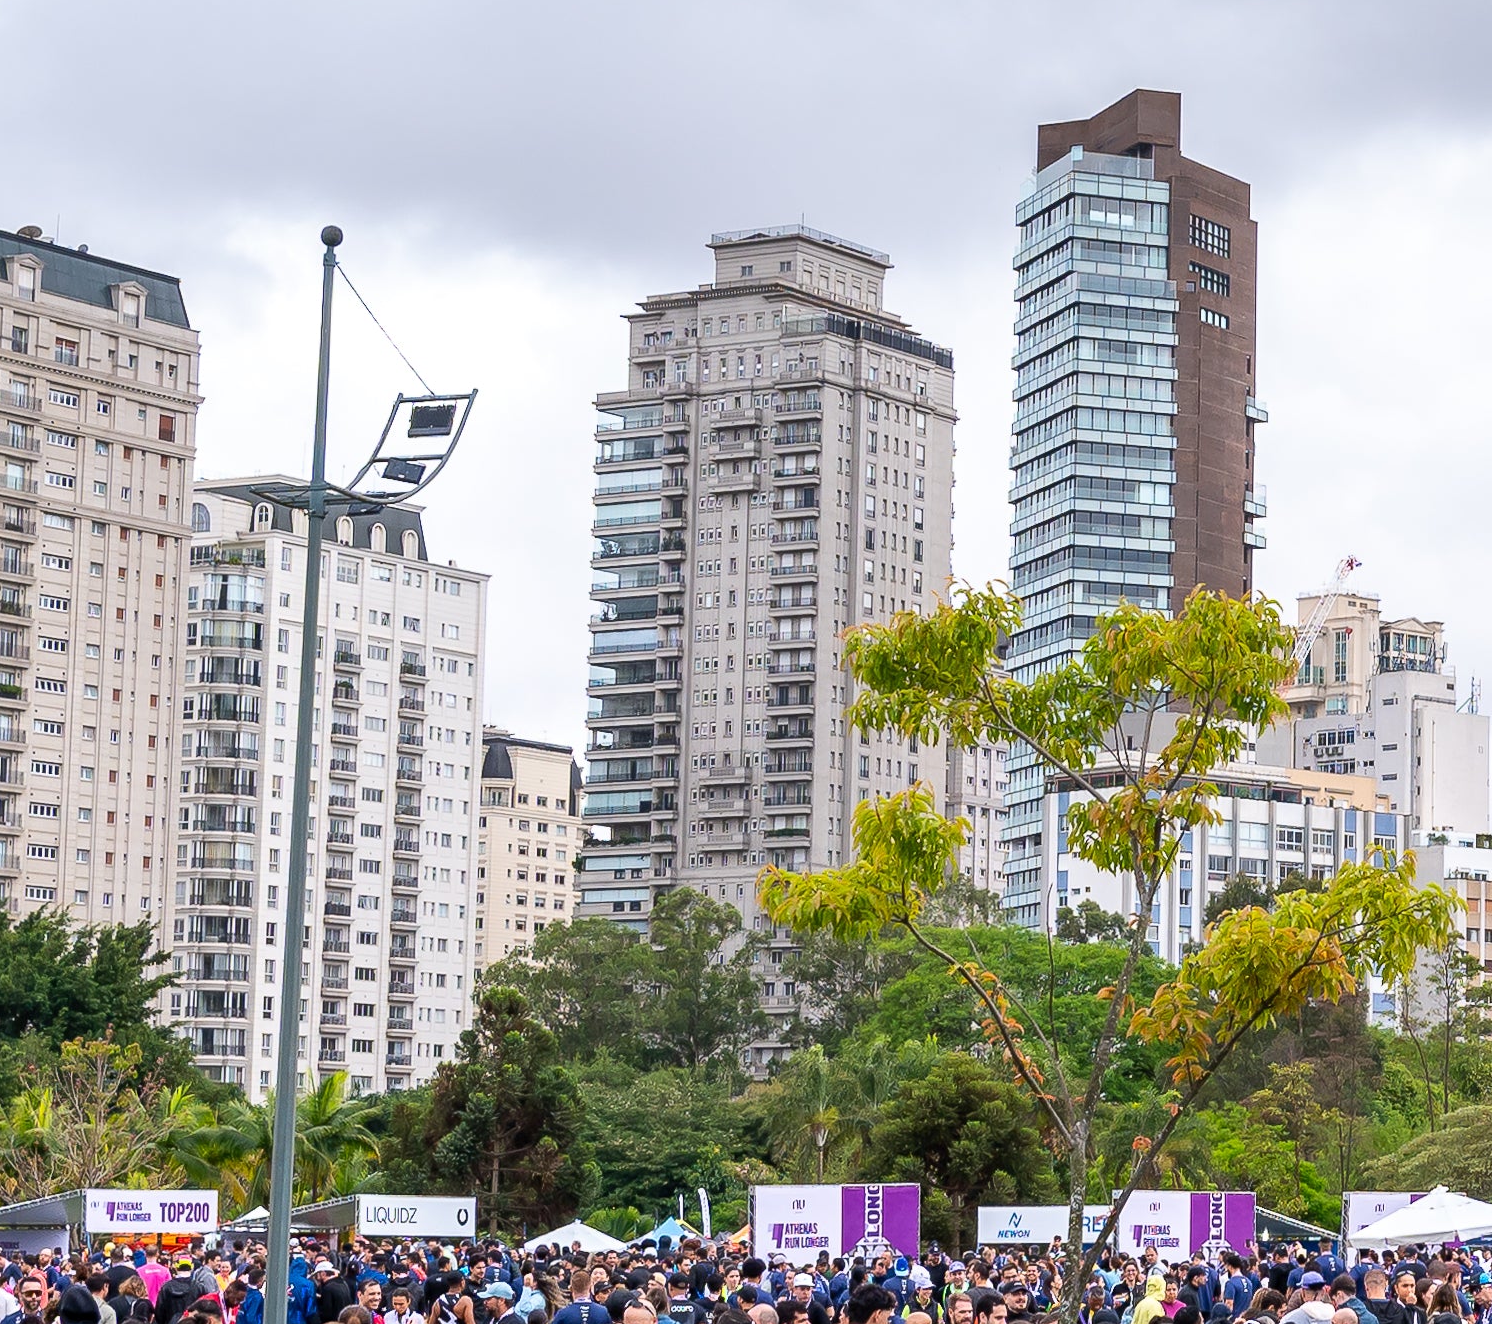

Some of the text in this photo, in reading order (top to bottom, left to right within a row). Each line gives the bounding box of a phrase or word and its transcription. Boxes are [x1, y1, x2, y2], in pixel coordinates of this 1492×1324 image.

[116, 1201, 142, 1211] ATHENAS
[160, 1202, 210, 1223] TOP200
[366, 1206, 418, 1225] LIQUIDZ
[784, 1223, 818, 1235] ATHENAS
[997, 1229, 1030, 1239] NEWON
[1144, 1225, 1170, 1236] ATHENAS
[784, 1237, 830, 1249] RUN LONGER
